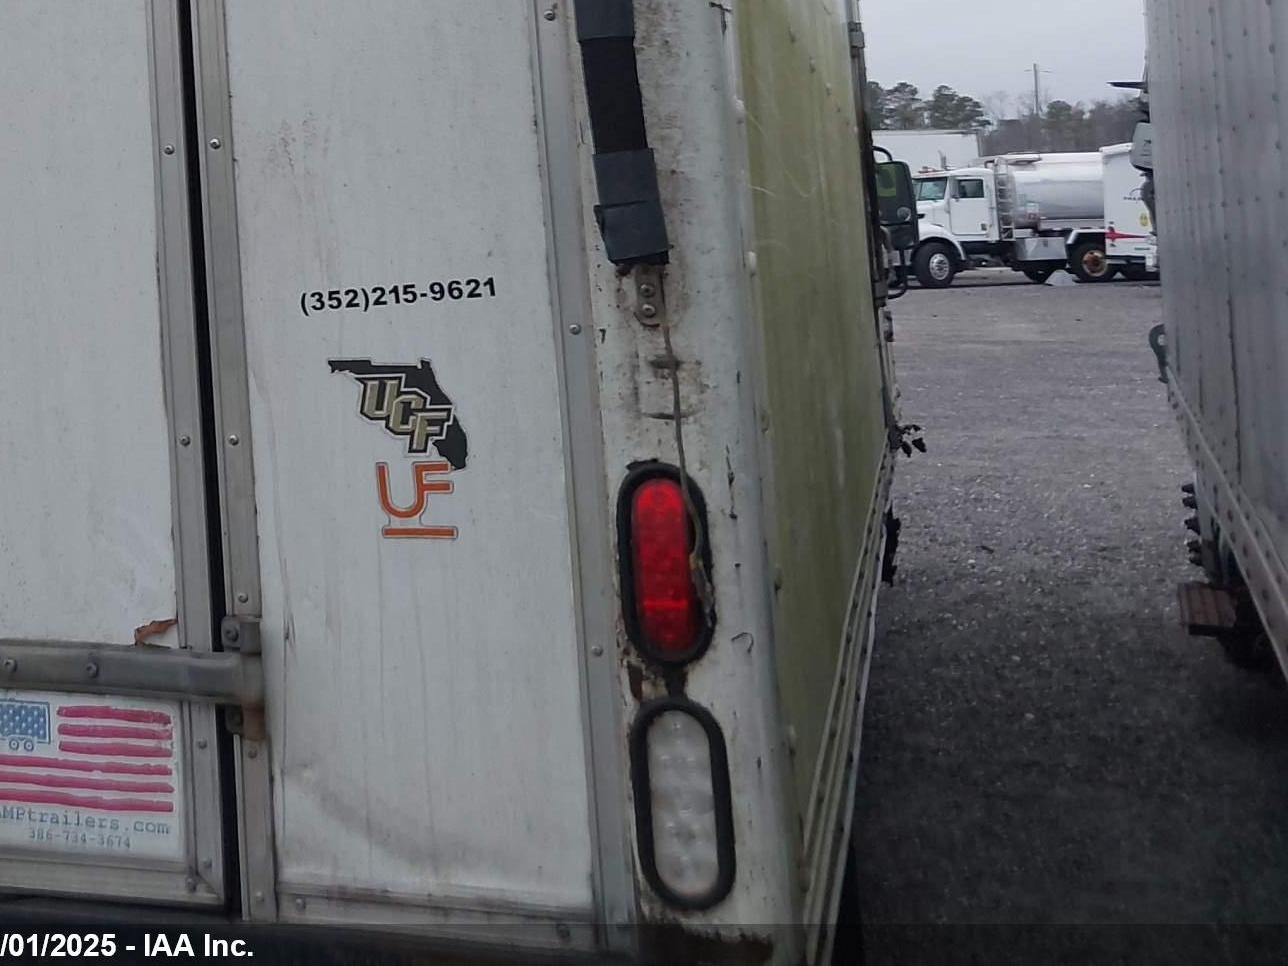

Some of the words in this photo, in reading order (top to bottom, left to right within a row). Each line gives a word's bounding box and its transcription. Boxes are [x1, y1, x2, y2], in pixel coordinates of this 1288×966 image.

[300, 277, 497, 318] (352)215-9621
[360, 376, 453, 453] UCF
[376, 462, 452, 518] UF
